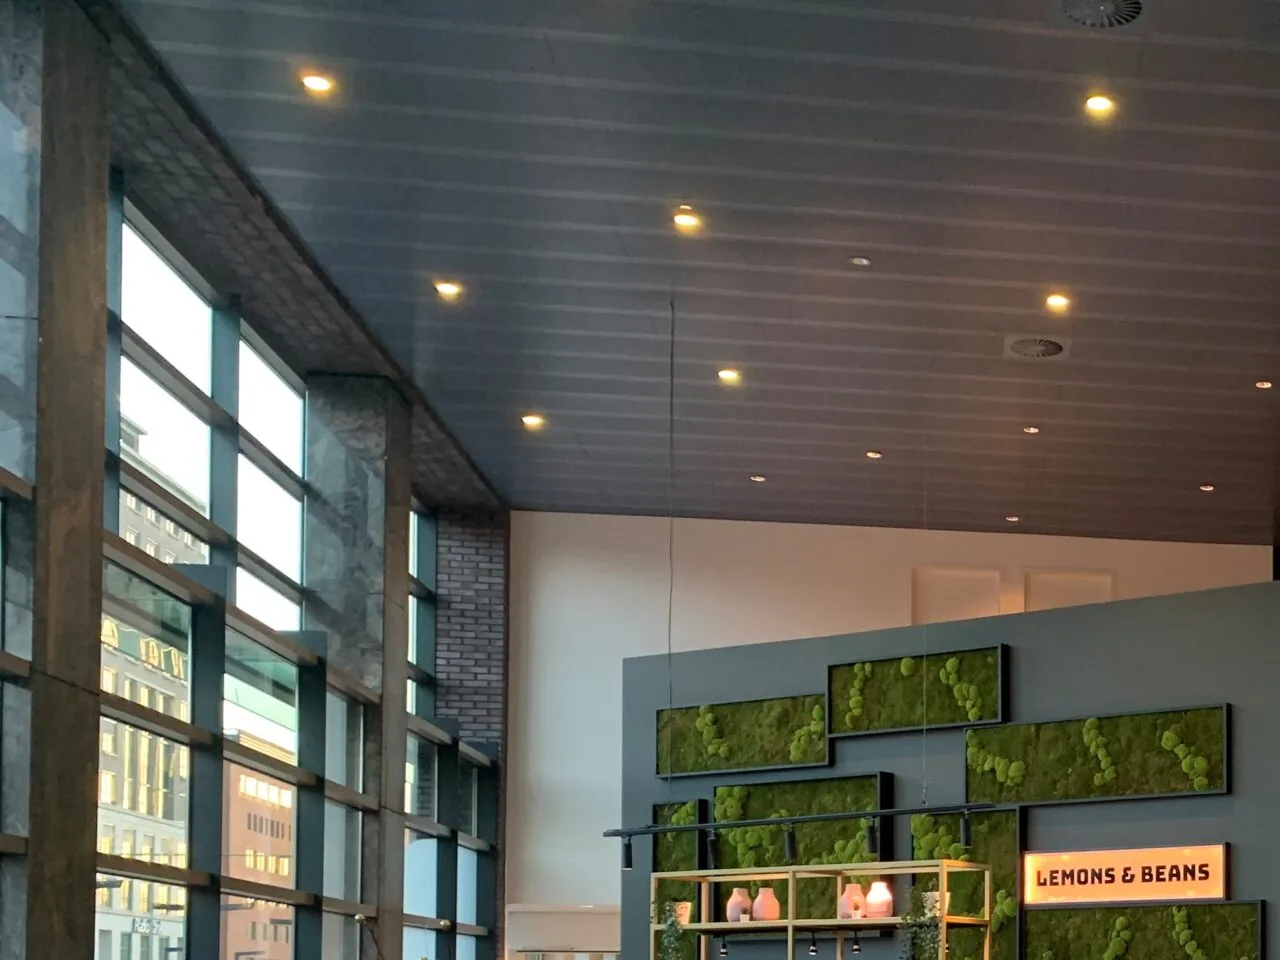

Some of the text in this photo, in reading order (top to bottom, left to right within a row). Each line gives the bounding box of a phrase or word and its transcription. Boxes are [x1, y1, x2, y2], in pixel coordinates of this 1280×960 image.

[1036, 863, 1210, 886] LEMONS & BEANS
